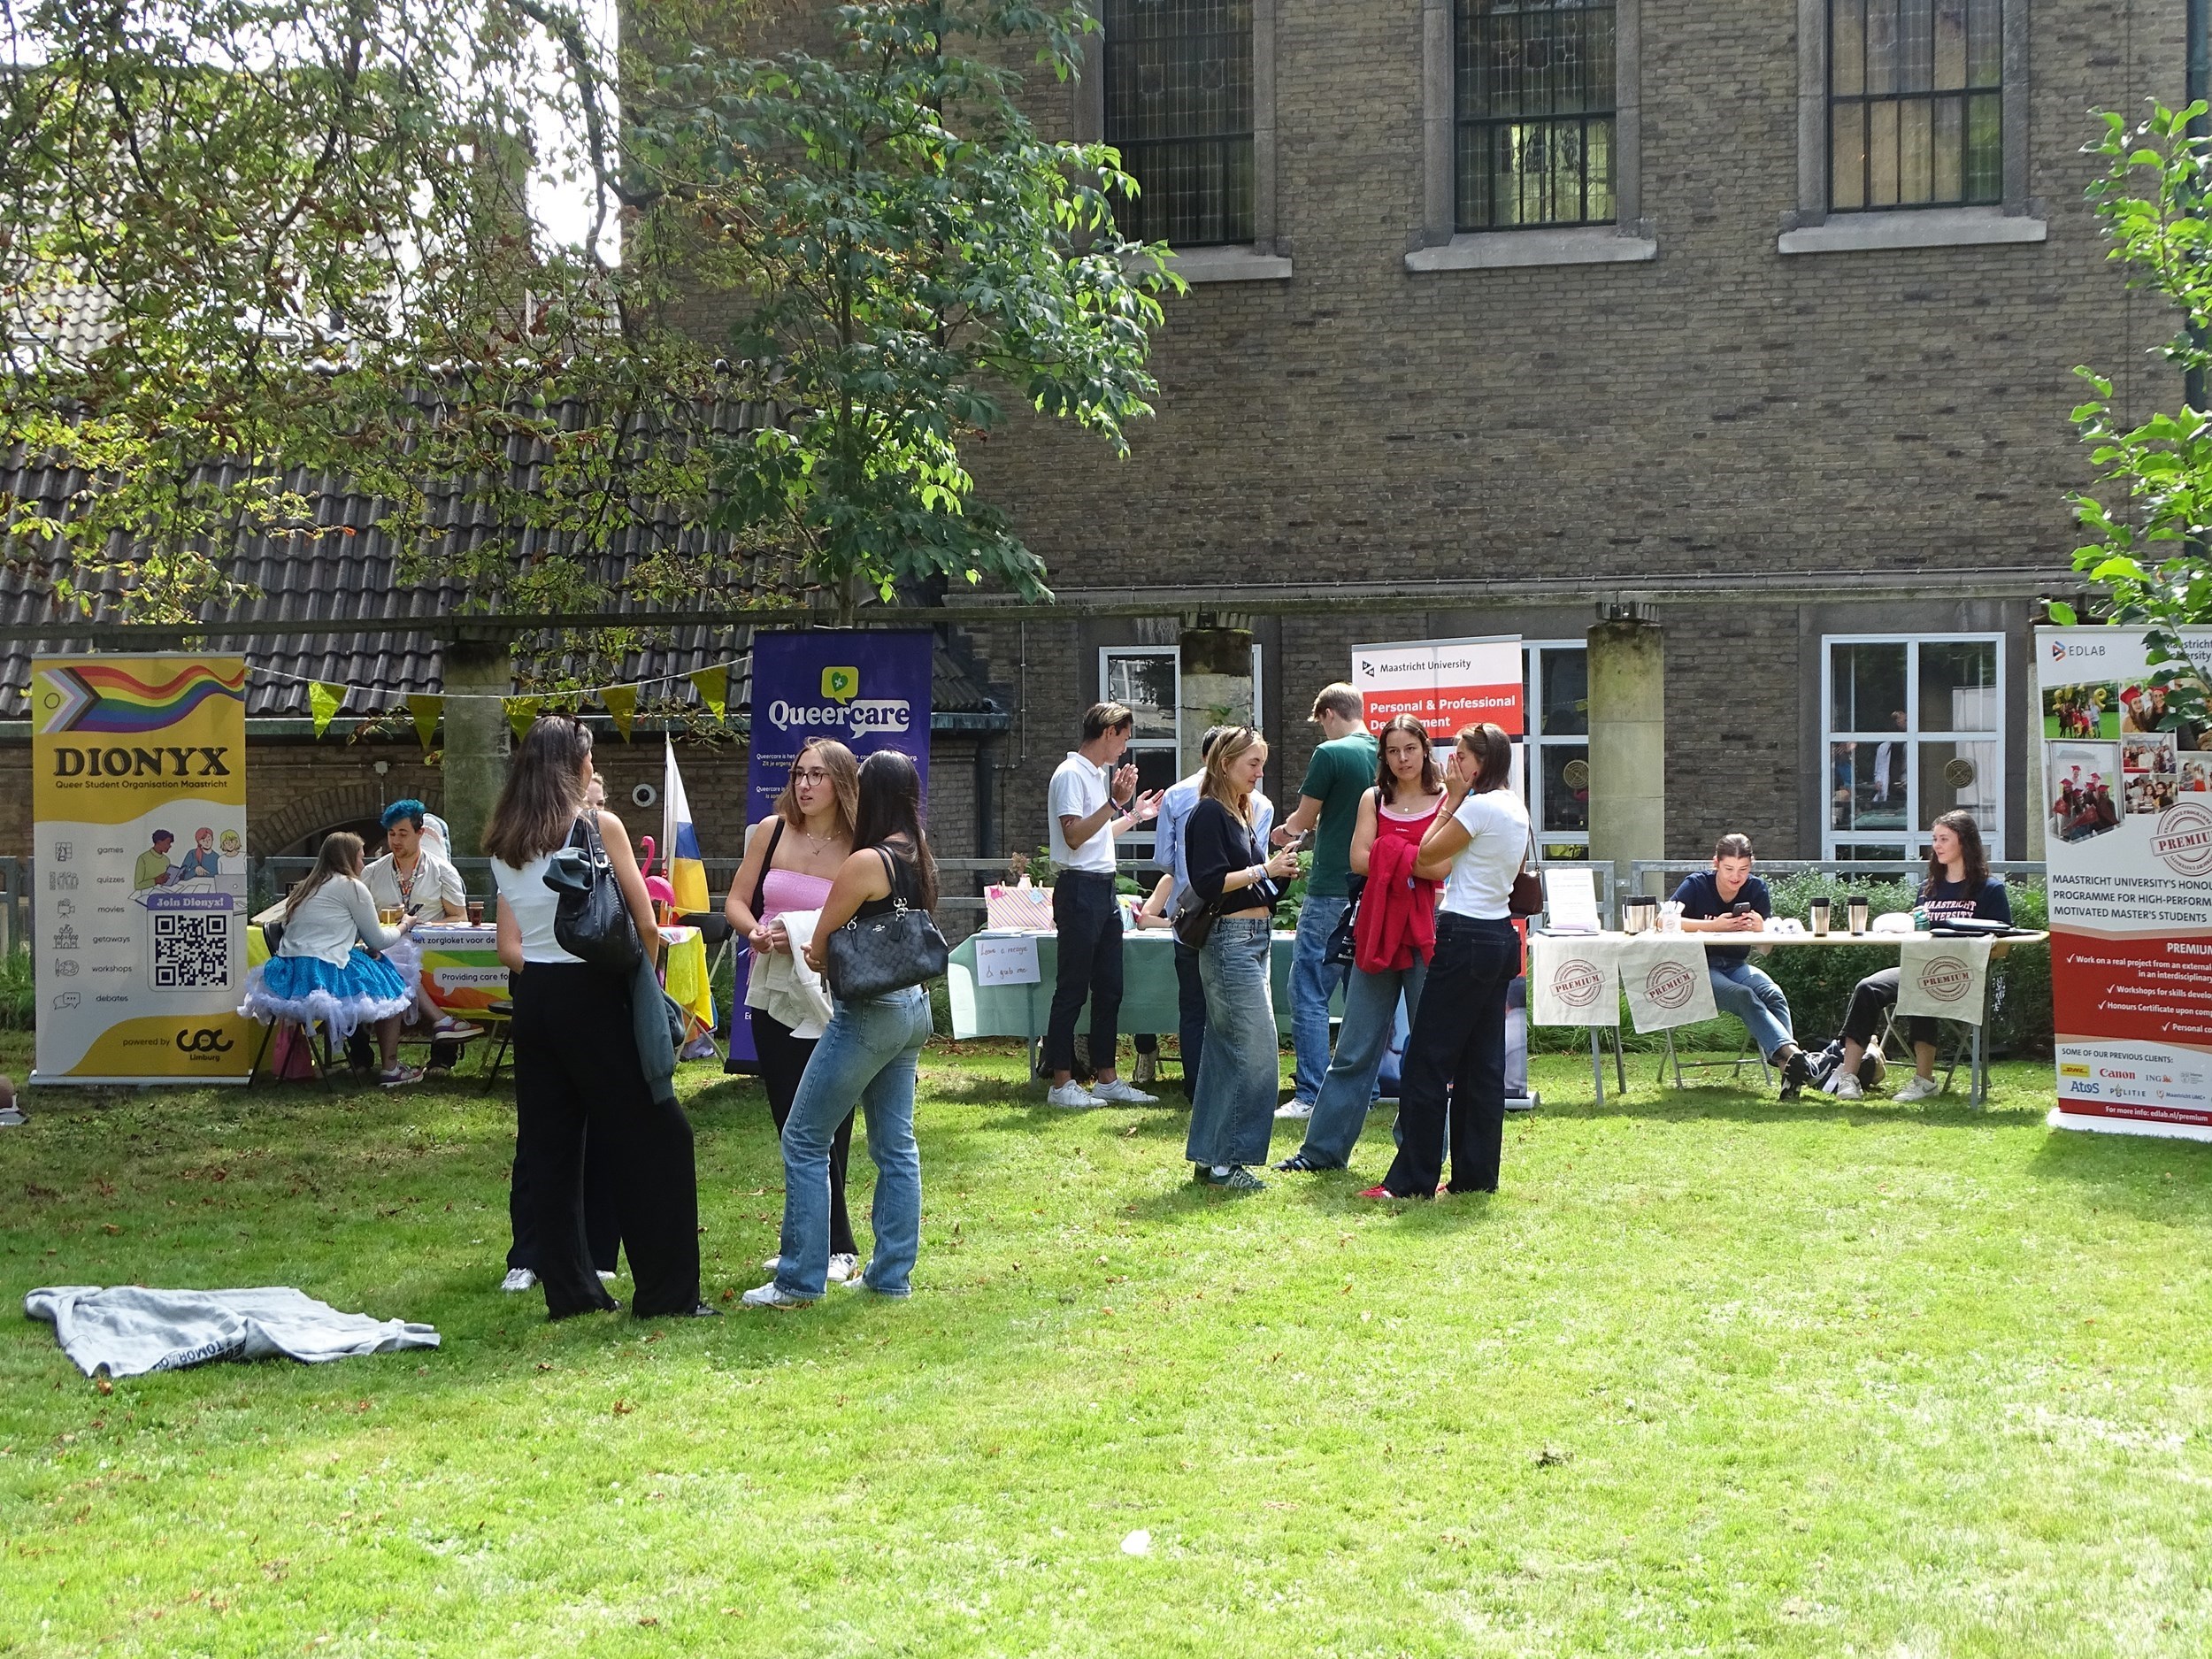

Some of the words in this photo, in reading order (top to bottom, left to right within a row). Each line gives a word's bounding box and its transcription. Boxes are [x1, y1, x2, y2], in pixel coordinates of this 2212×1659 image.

[2069, 645, 2106, 657] EDLAB
[1380, 663, 1425, 673] Maastricht
[1428, 658, 1471, 670] University
[1370, 701, 1423, 713] Personal
[1426, 700, 1436, 710] &
[1440, 695, 1516, 710] Professional
[768, 700, 910, 732] Queercare
[1370, 716, 1451, 730] Dement
[54, 747, 230, 777] DIONYX
[121, 780, 178, 789] Organisation
[180, 780, 227, 788] Maastricht
[2158, 831, 2212, 851] PREMIU
[97, 875, 125, 885] quizzes
[2053, 875, 2112, 887] MAASTRICHT
[2114, 877, 2177, 889] UNIVERSITY'S
[157, 897, 180, 907] Join
[183, 897, 224, 908] Dionyx!
[2054, 891, 2116, 902] PROGRAMME
[2117, 894, 2136, 902] FOR
[2139, 895, 2212, 907] HIGH-PERFORM
[1924, 901, 1977, 910] MAASTRICHT
[1927, 911, 1974, 921] IVERSITY
[2054, 906, 2108, 918] MOTIVATED
[2111, 909, 2156, 919] MASTER'S
[2159, 912, 2208, 922] STUDENTS
[92, 935, 131, 944] getaways
[92, 964, 133, 973] workshops
[2127, 959, 2152, 969] project
[442, 973, 478, 982] Providing
[1555, 974, 1600, 993] PREMIUM
[1923, 972, 1970, 987] PREMIUM
[1649, 973, 1691, 998] PREMIUM
[96, 994, 129, 1002] debates
[2116, 985, 2156, 995] Workshops
[2169, 988, 2186, 997] skills
[2188, 990, 2212, 999] develo
[2108, 1002, 2137, 1010] Honours
[2138, 1004, 2175, 1013] Certificate
[2172, 1023, 2203, 1033] Personal
[160, 1038, 170, 1047] by
[176, 1029, 234, 1052] COC
[2109, 1052, 2143, 1061] PREVIOUS
[2144, 1055, 2173, 1064] CLIENTS:
[2100, 1068, 2136, 1079] Canon
[2150, 1111, 2208, 1122] edlab.nl/premium
